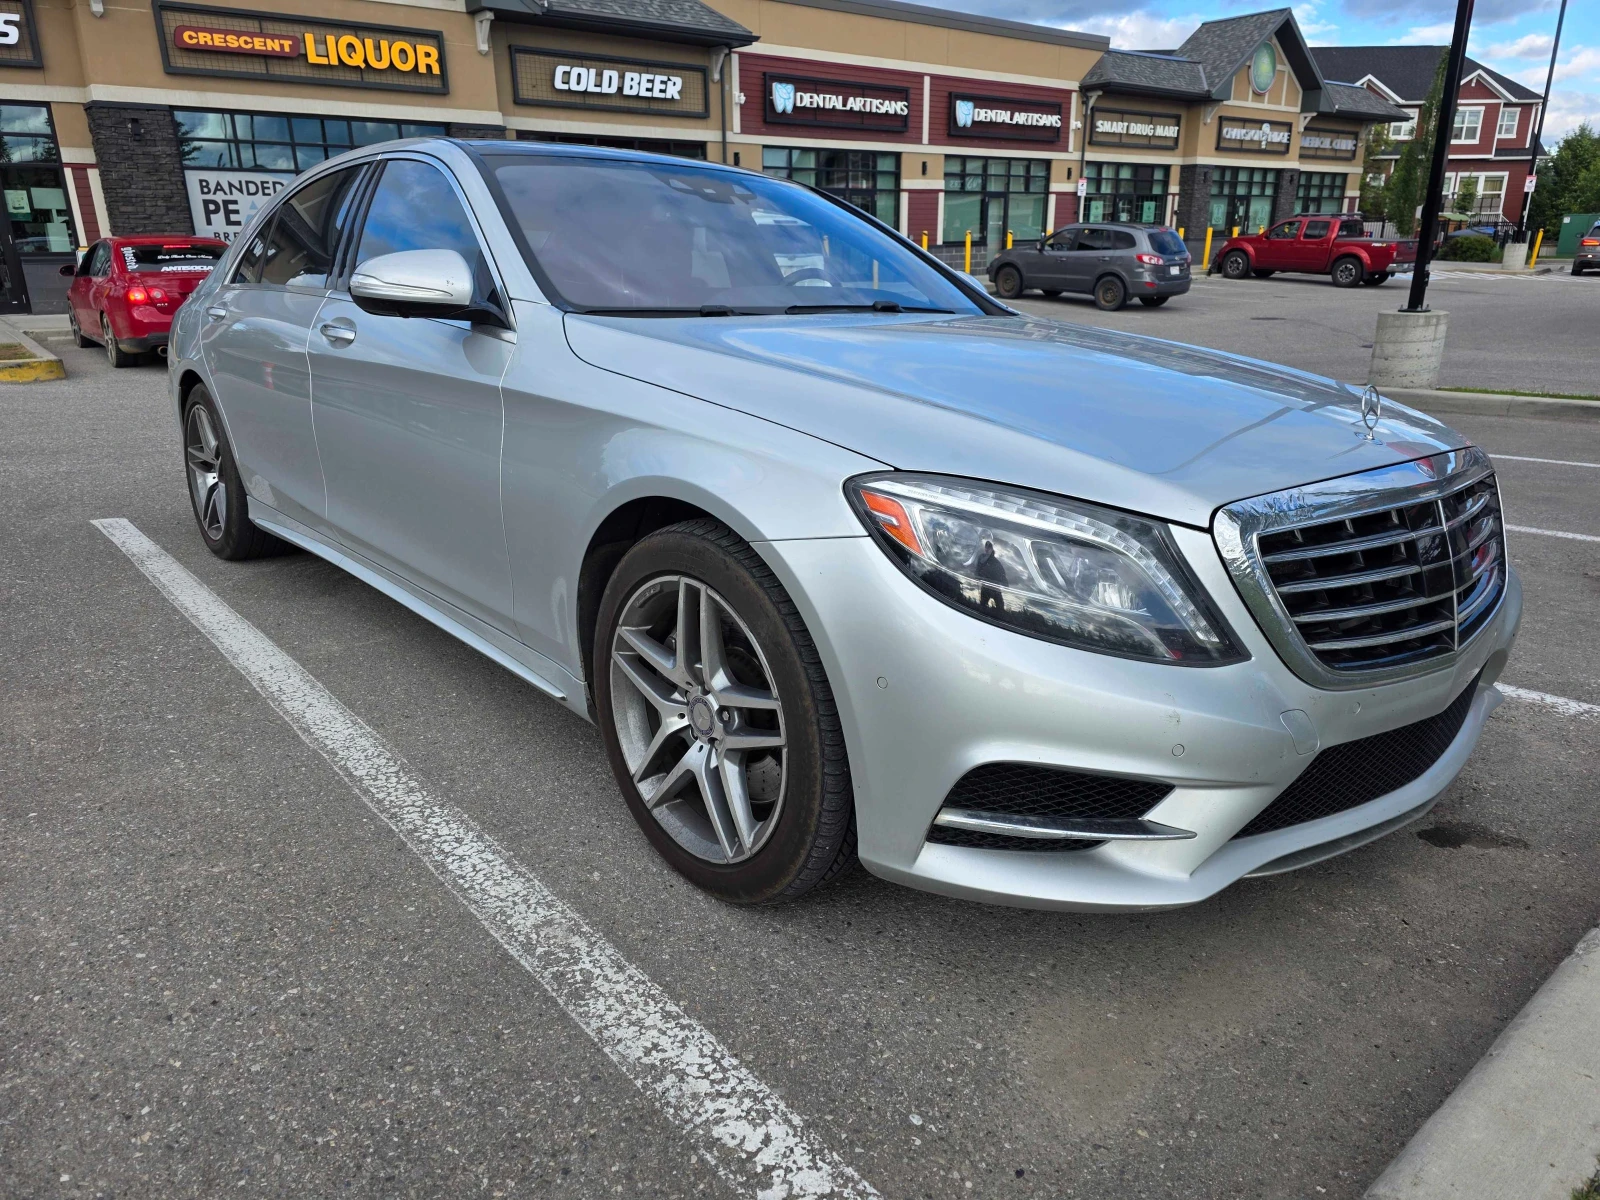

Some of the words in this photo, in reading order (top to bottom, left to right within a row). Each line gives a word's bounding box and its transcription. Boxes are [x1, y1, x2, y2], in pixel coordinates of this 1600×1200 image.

[182, 30, 293, 53] CRESCENT
[303, 32, 441, 75] LIQUOR
[554, 65, 619, 94] COLD
[622, 71, 683, 100] BEER
[1096, 120, 1128, 134] SMART
[1129, 122, 1154, 136] DRUG
[1155, 125, 1179, 138] MART
[198, 178, 285, 197] BANDED
